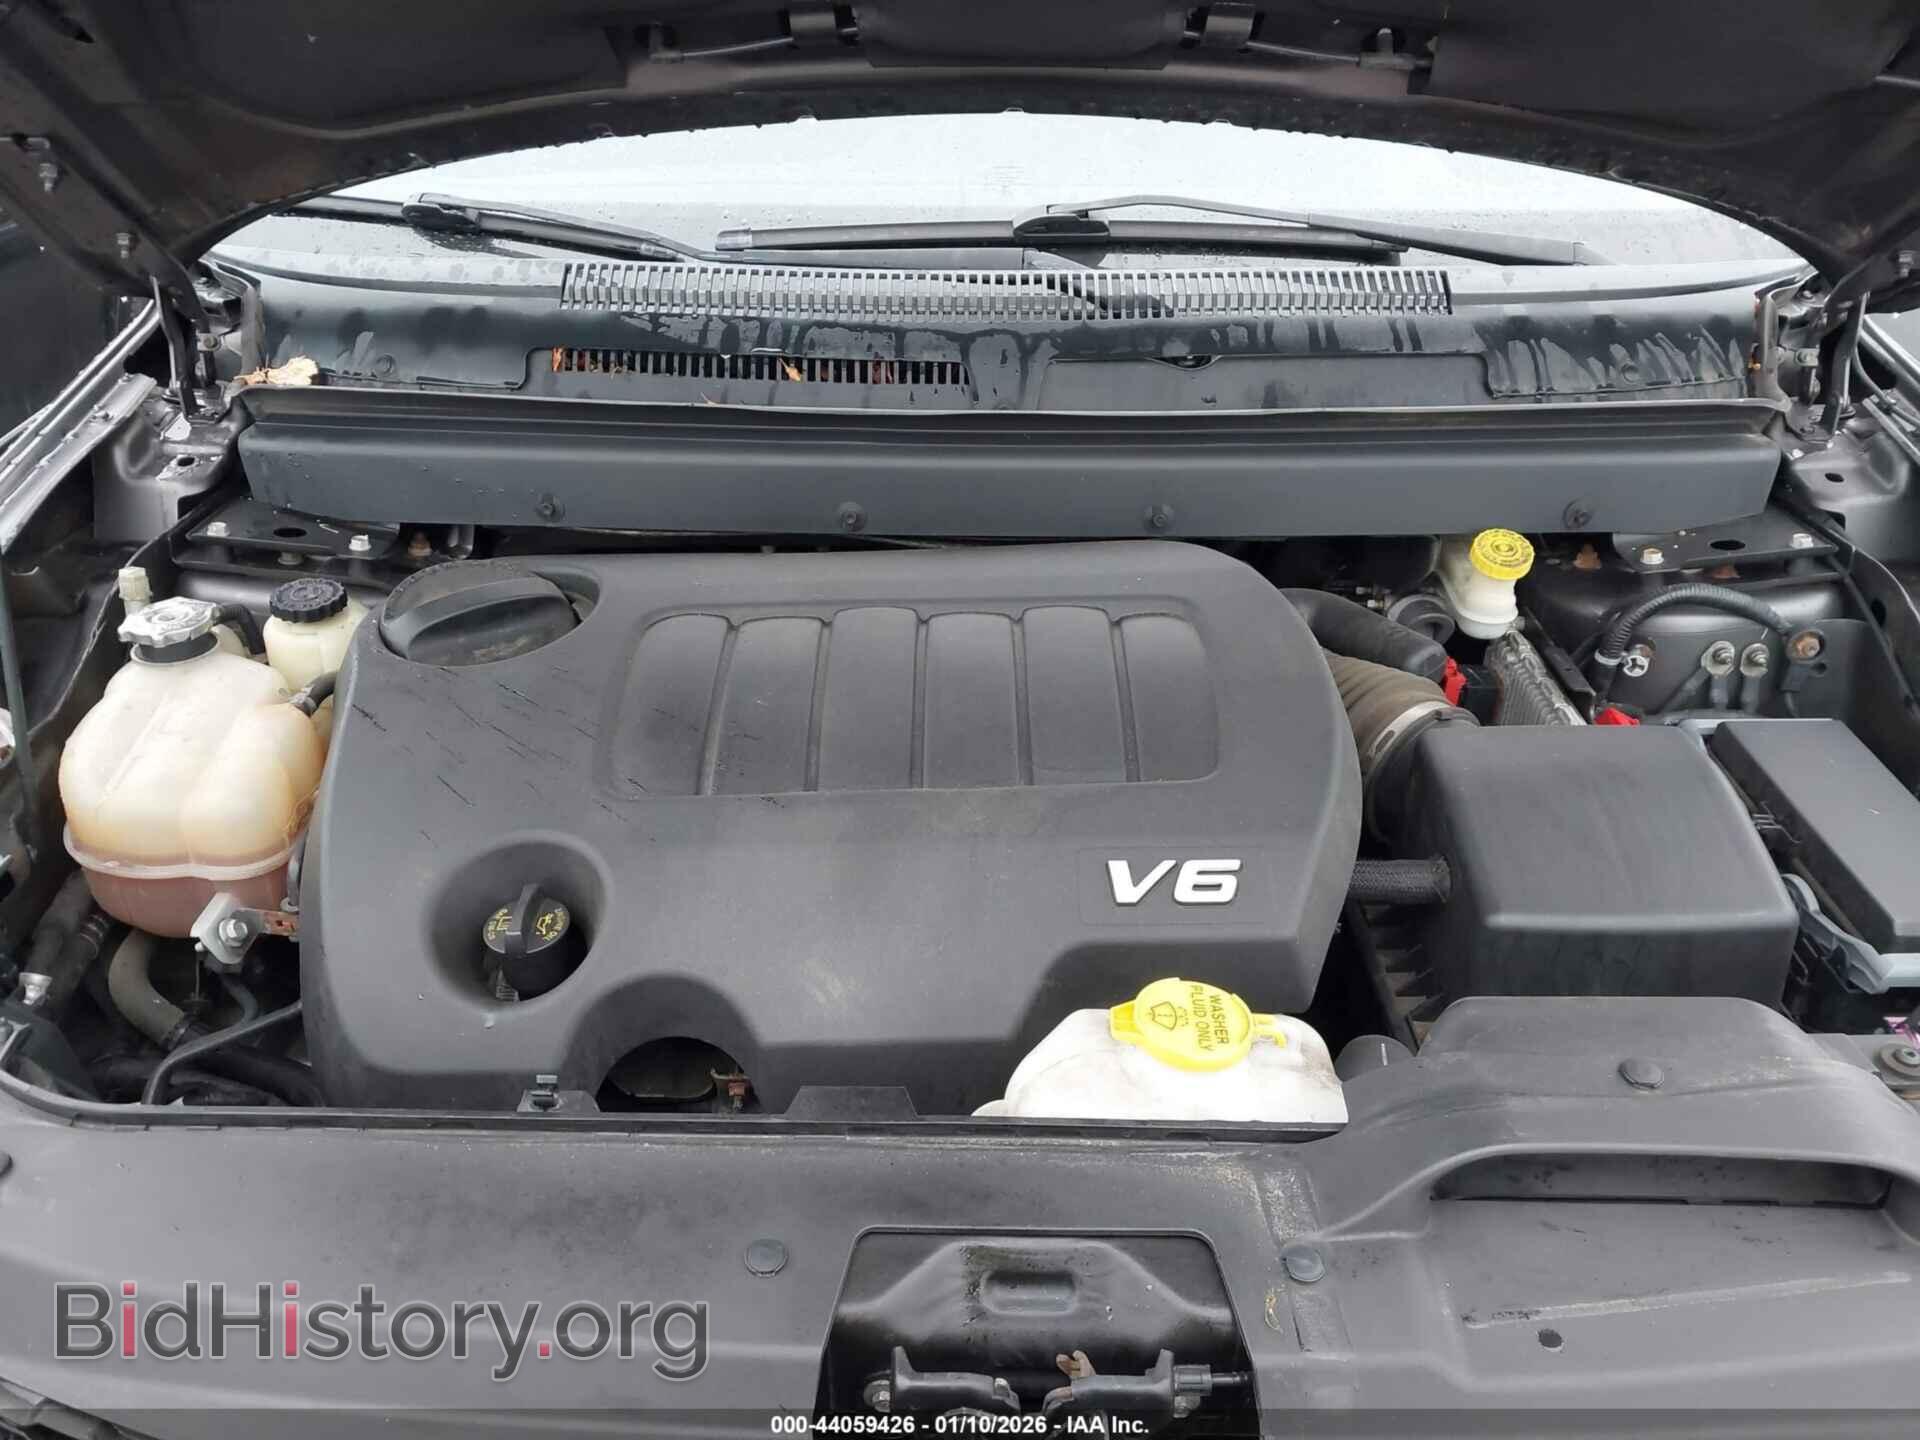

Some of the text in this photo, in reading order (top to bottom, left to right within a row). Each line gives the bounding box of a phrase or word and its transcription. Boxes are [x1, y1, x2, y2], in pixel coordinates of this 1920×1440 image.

[1106, 859, 1242, 905] V6
[1190, 984, 1216, 1052] FLUID ONLY
[1209, 994, 1230, 1045] WASHER
